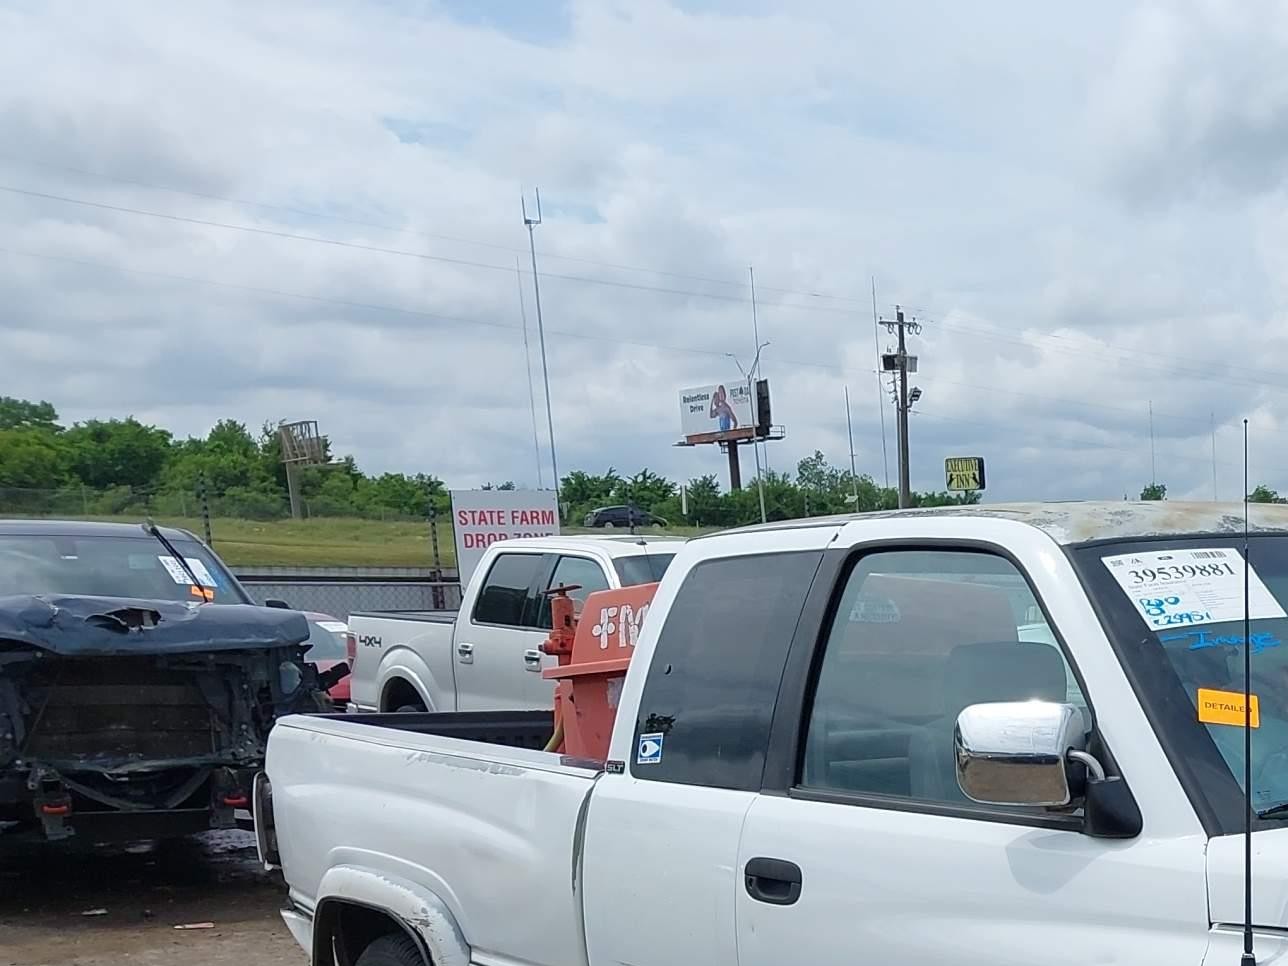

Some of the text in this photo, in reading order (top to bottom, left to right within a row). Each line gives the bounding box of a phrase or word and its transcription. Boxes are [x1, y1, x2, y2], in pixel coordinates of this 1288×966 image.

[690, 405, 704, 413] Drive
[956, 473, 970, 489] INN
[458, 510, 555, 526] STATE FARM
[1128, 562, 1237, 585] 39539881
[607, 763, 624, 773] SLT
